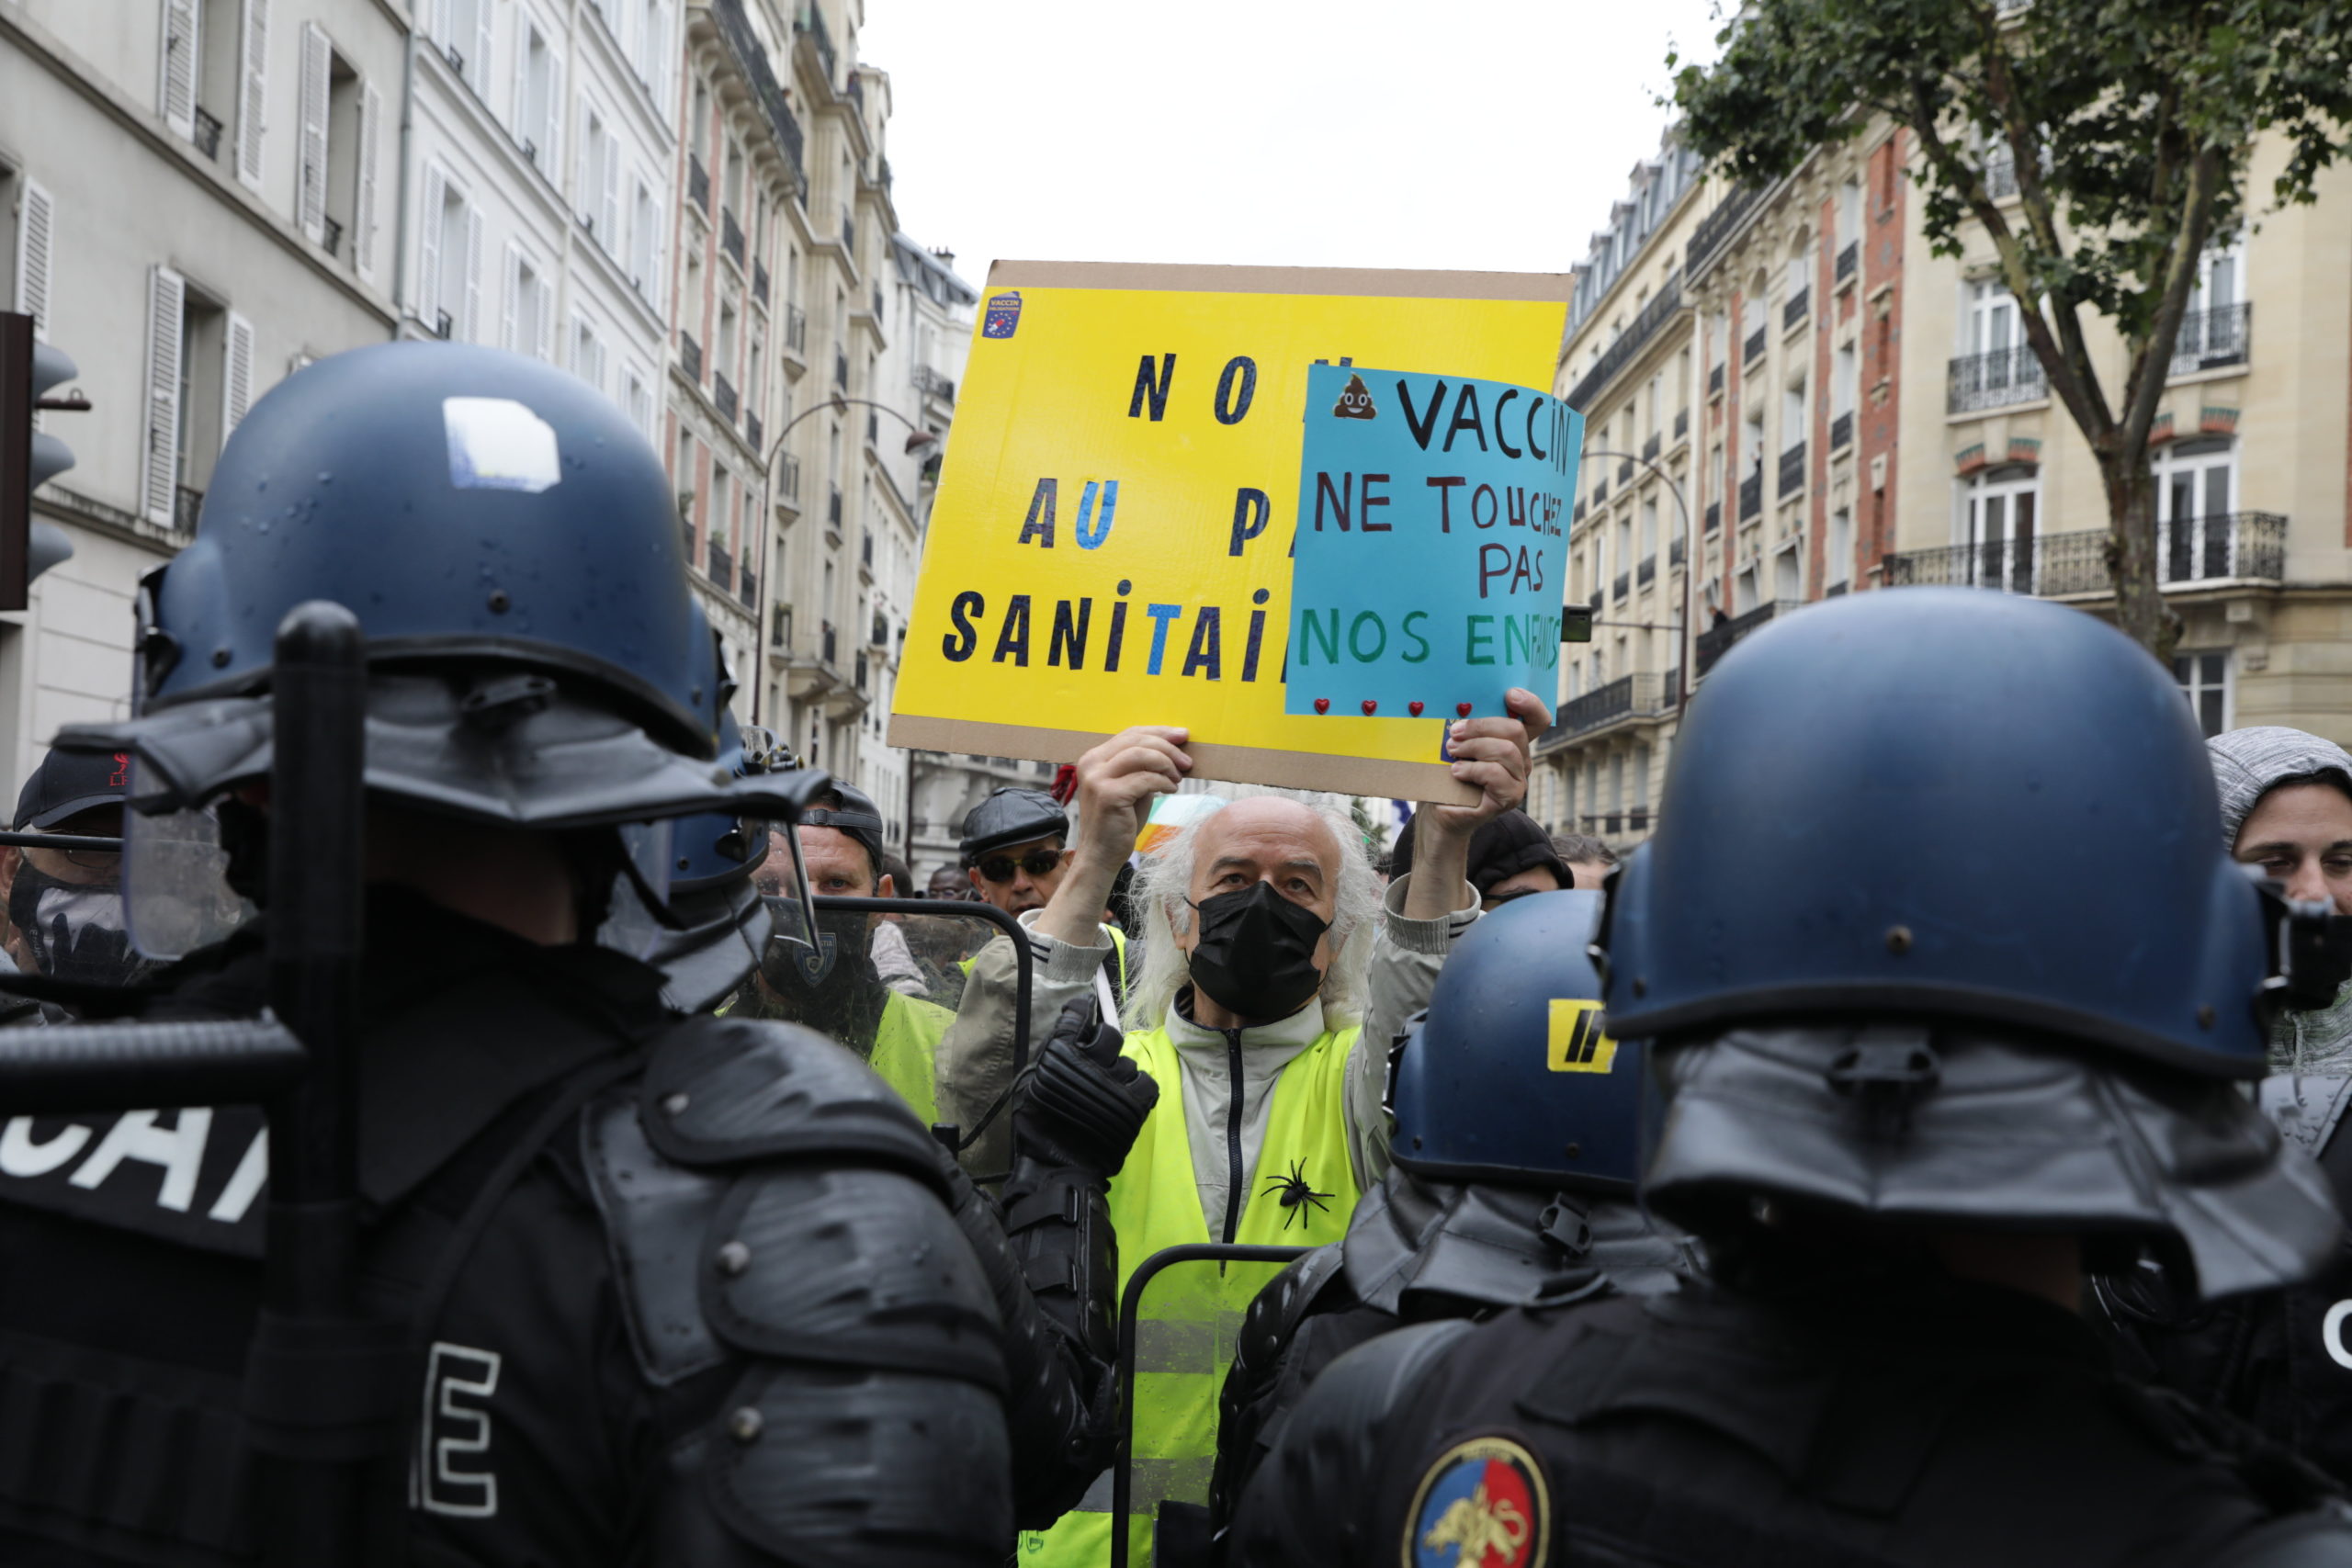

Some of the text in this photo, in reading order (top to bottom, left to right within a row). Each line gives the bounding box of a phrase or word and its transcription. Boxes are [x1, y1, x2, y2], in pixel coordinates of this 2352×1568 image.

[1017, 478, 1119, 550] AU
[1315, 471, 1562, 537] NE TOUCHEZ
[1479, 543, 1544, 599] PAS
[1298, 607, 1430, 665] NOS
[410, 1342, 502, 1517] E
